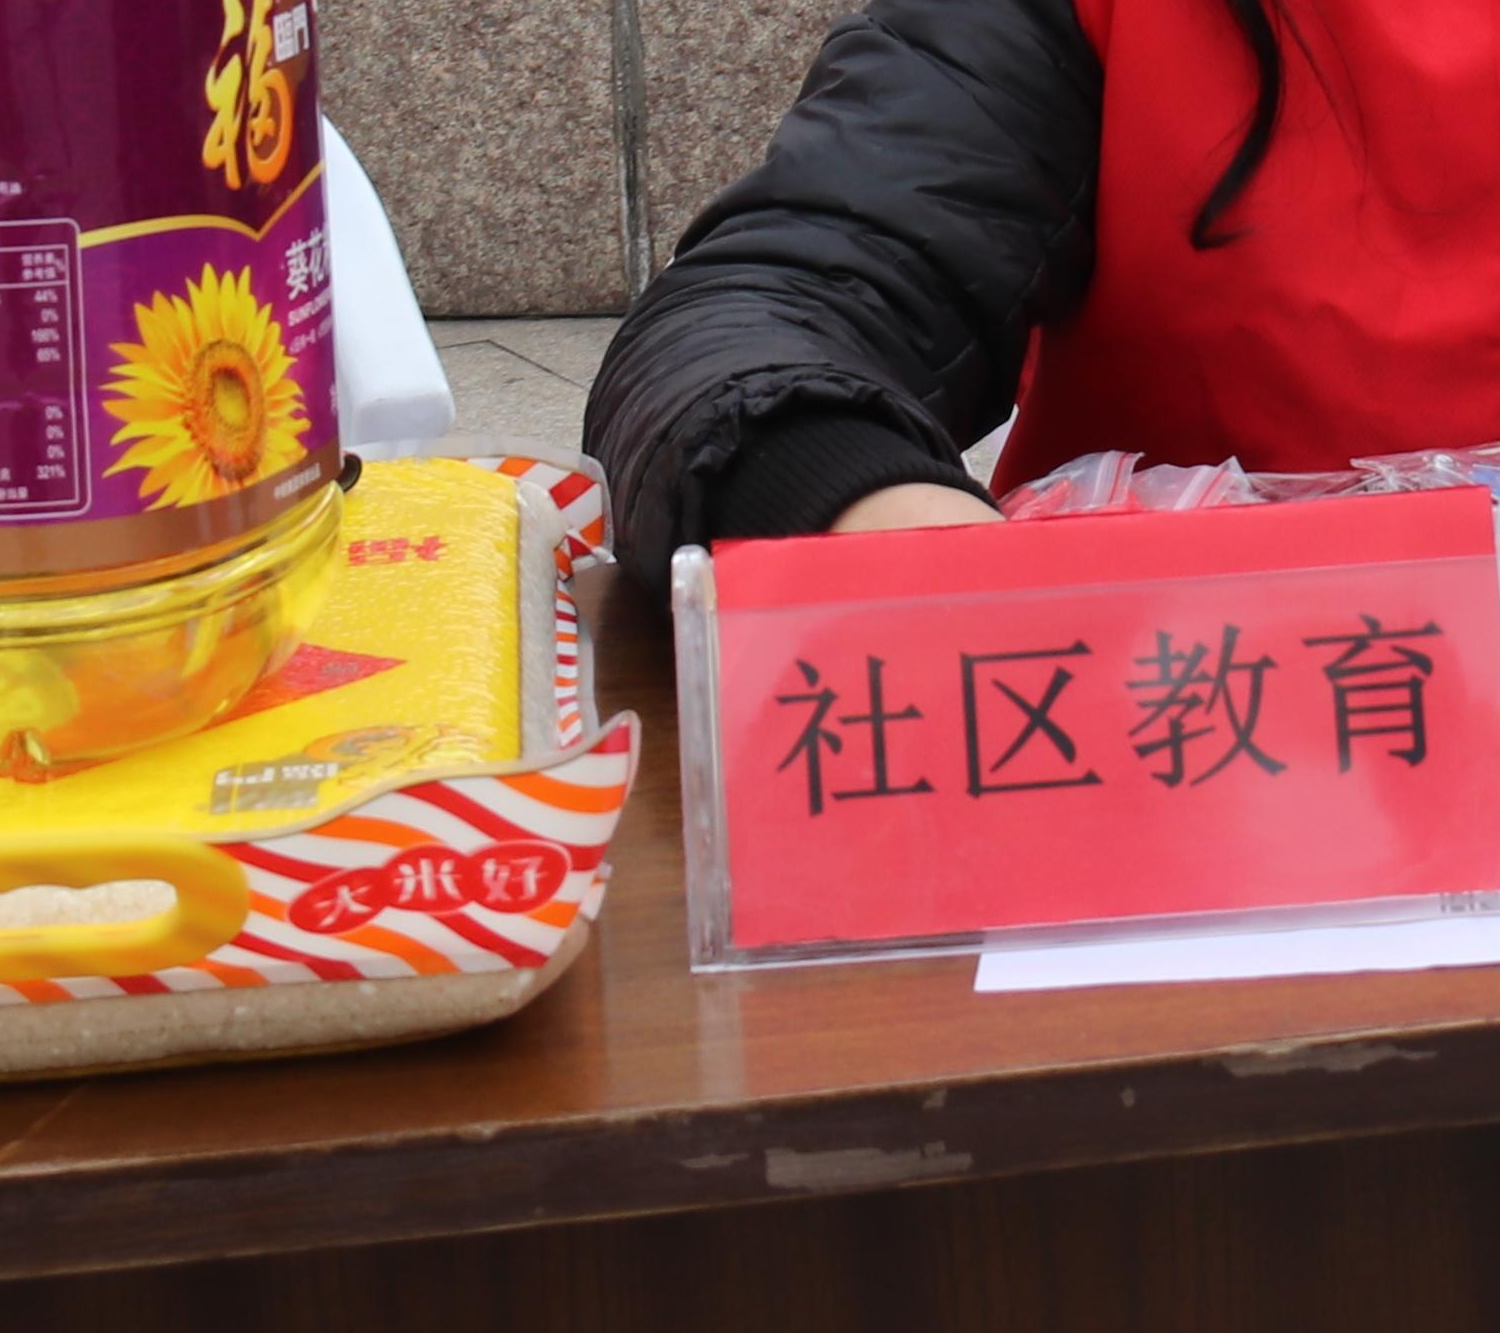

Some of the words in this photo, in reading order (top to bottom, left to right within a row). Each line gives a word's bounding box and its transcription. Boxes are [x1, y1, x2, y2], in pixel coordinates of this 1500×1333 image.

[773, 613, 1443, 819] 社区教育
[312, 854, 548, 928] 大米好
